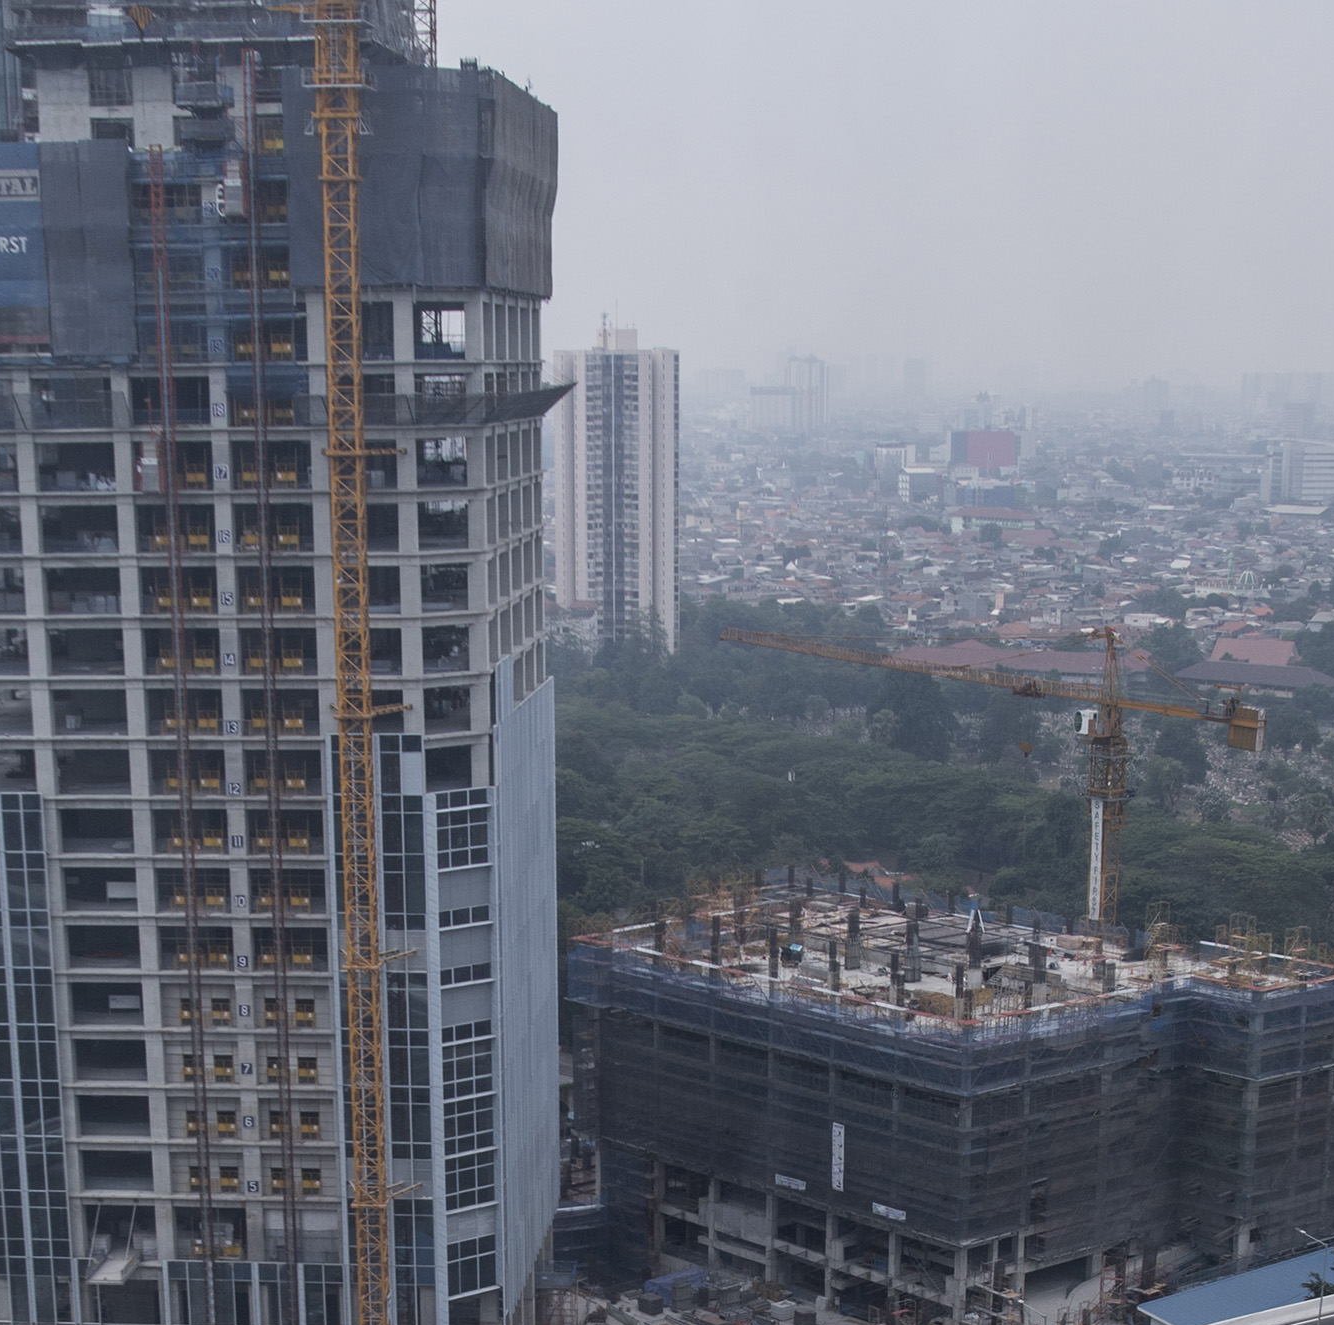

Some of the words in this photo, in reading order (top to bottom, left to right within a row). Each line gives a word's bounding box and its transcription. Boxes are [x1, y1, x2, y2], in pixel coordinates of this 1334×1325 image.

[212, 403, 225, 416] 18
[214, 465, 228, 479] 17
[218, 531, 230, 543] 16
[220, 592, 233, 605] 15
[223, 654, 235, 665] 14
[226, 721, 238, 732] 13
[229, 783, 240, 794] 12
[1092, 800, 1101, 861] SAFETY
[234, 895, 245, 906] 10
